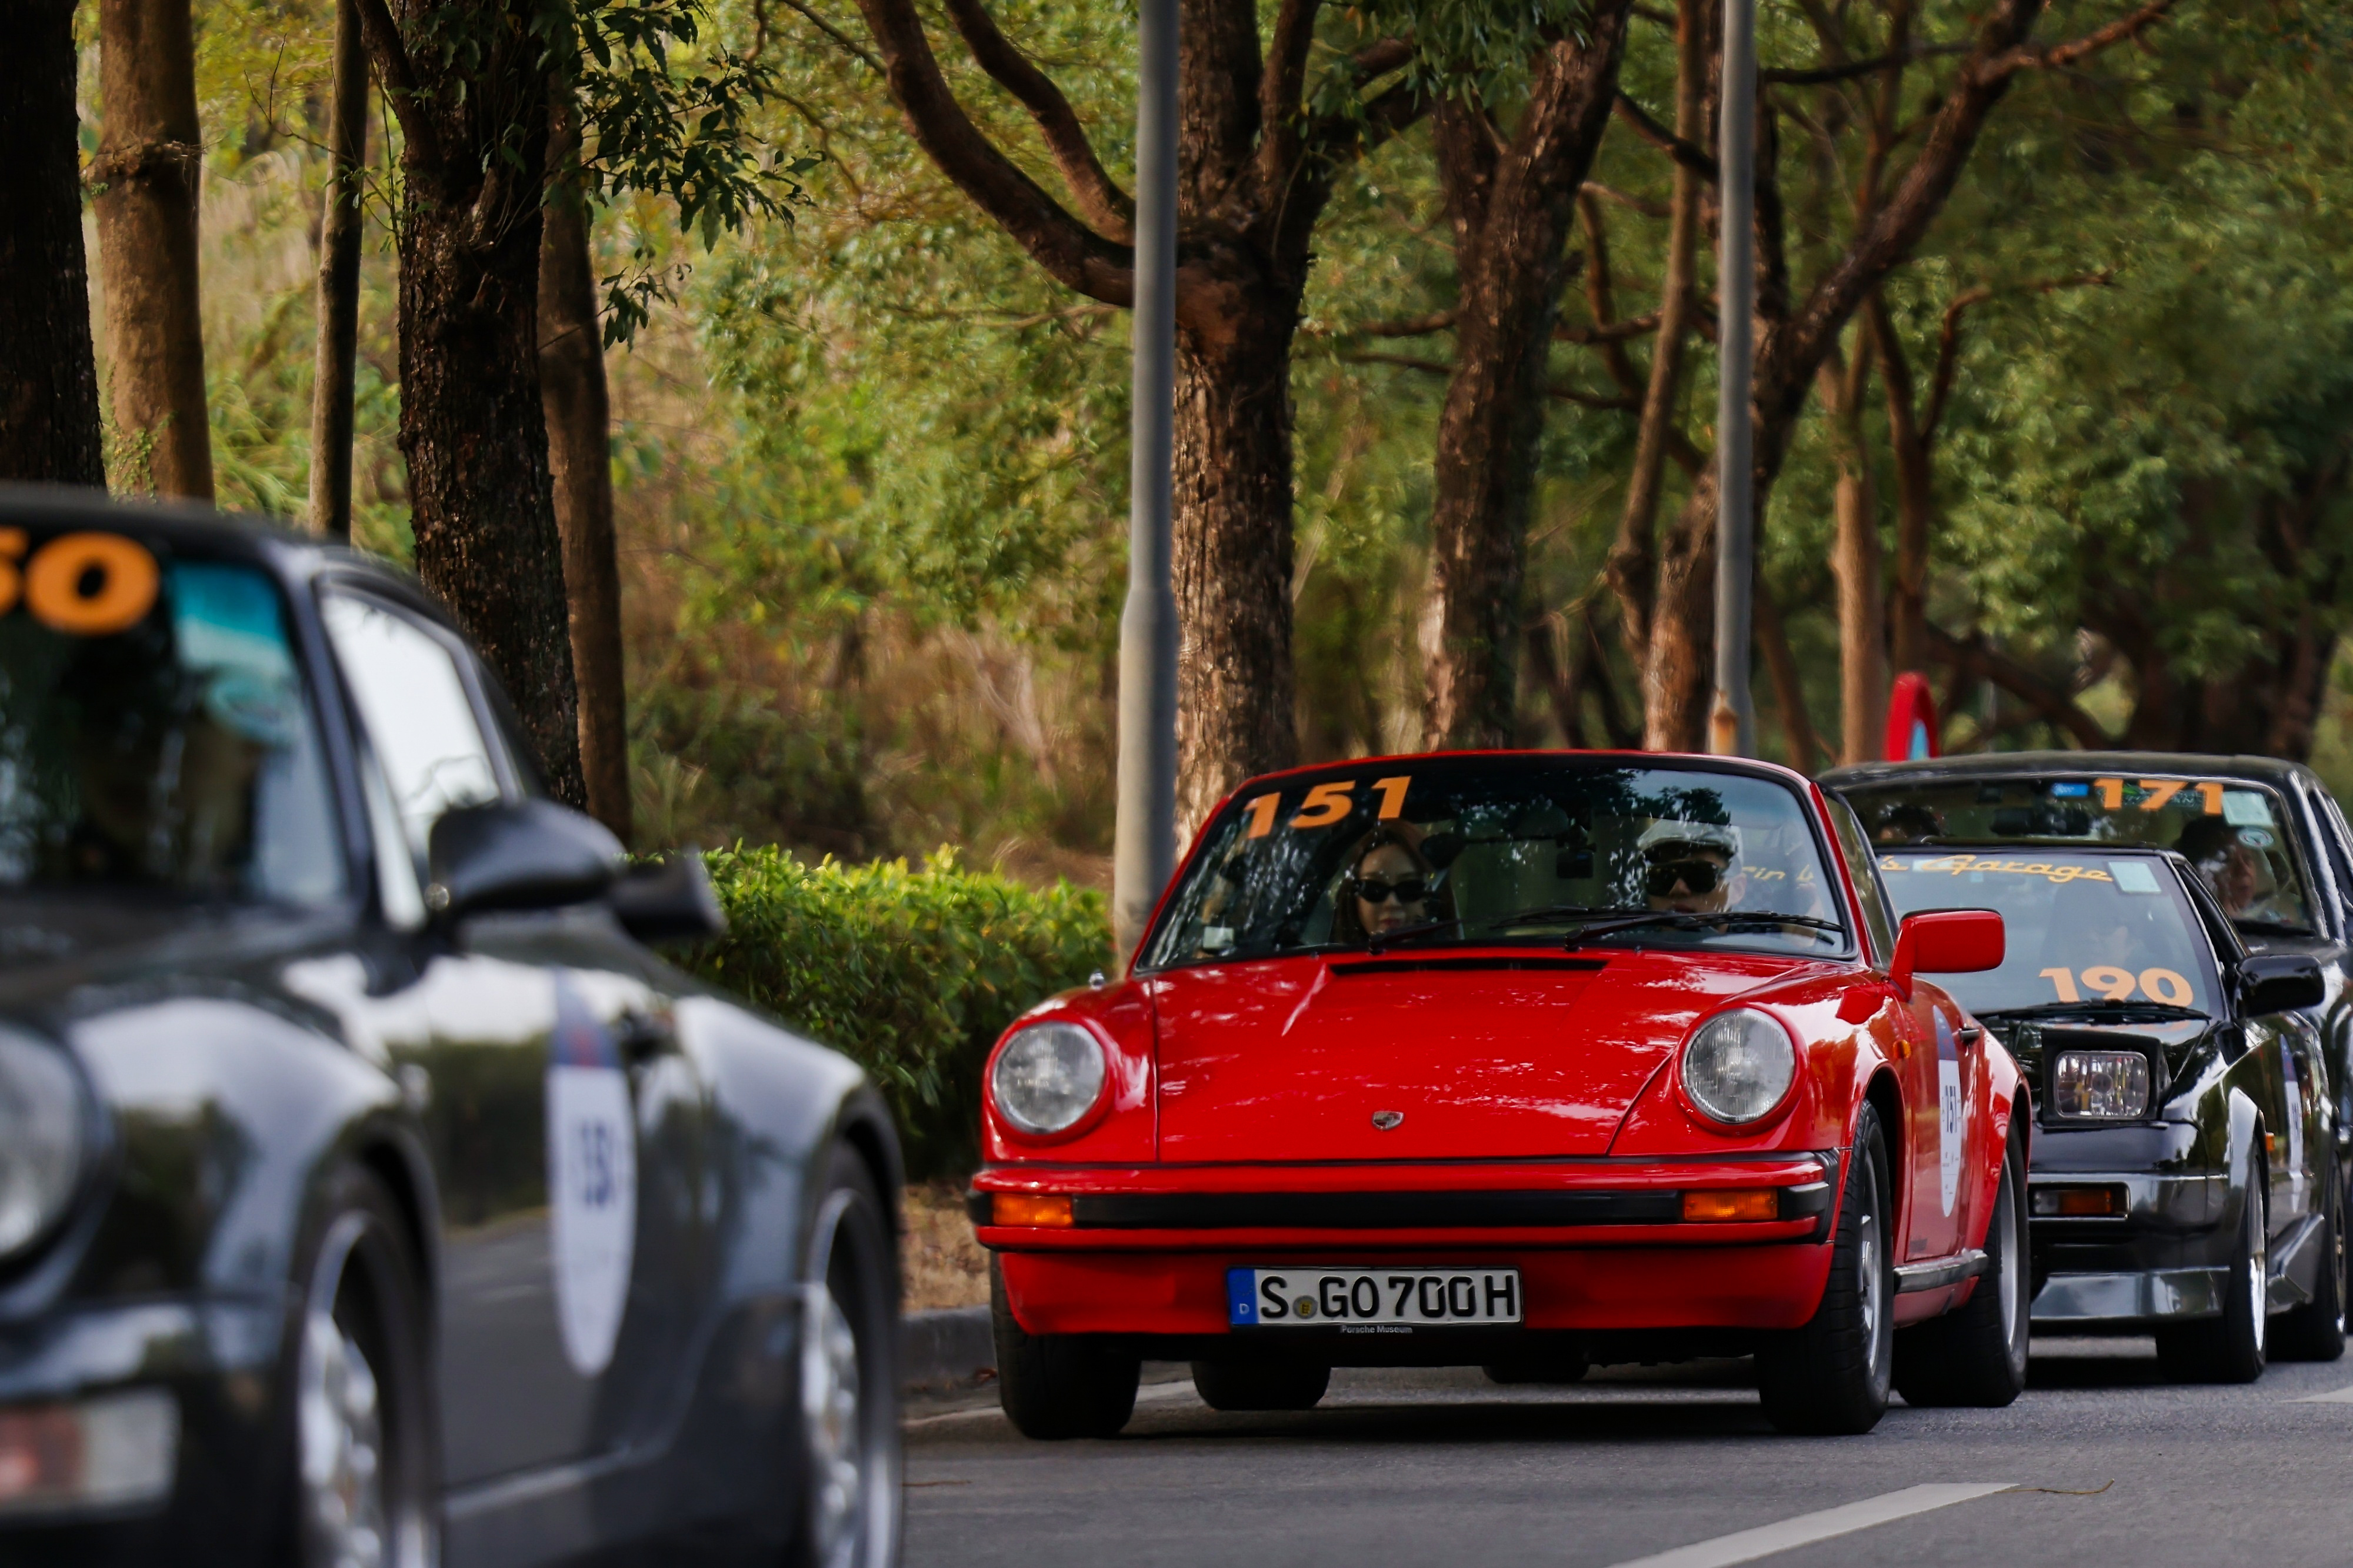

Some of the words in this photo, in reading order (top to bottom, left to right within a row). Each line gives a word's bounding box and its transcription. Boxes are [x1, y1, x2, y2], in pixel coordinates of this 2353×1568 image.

[1244, 776, 1412, 839] 151
[2094, 777, 2224, 815] 171
[1921, 855, 2114, 882] Garage
[2039, 966, 2194, 1007] 190
[1945, 1085, 1958, 1133] 151
[1239, 1303, 1250, 1315] D
[1261, 1276, 1289, 1318] S
[1342, 1325, 1375, 1333] Porsche
[1377, 1325, 1413, 1333] Museum
